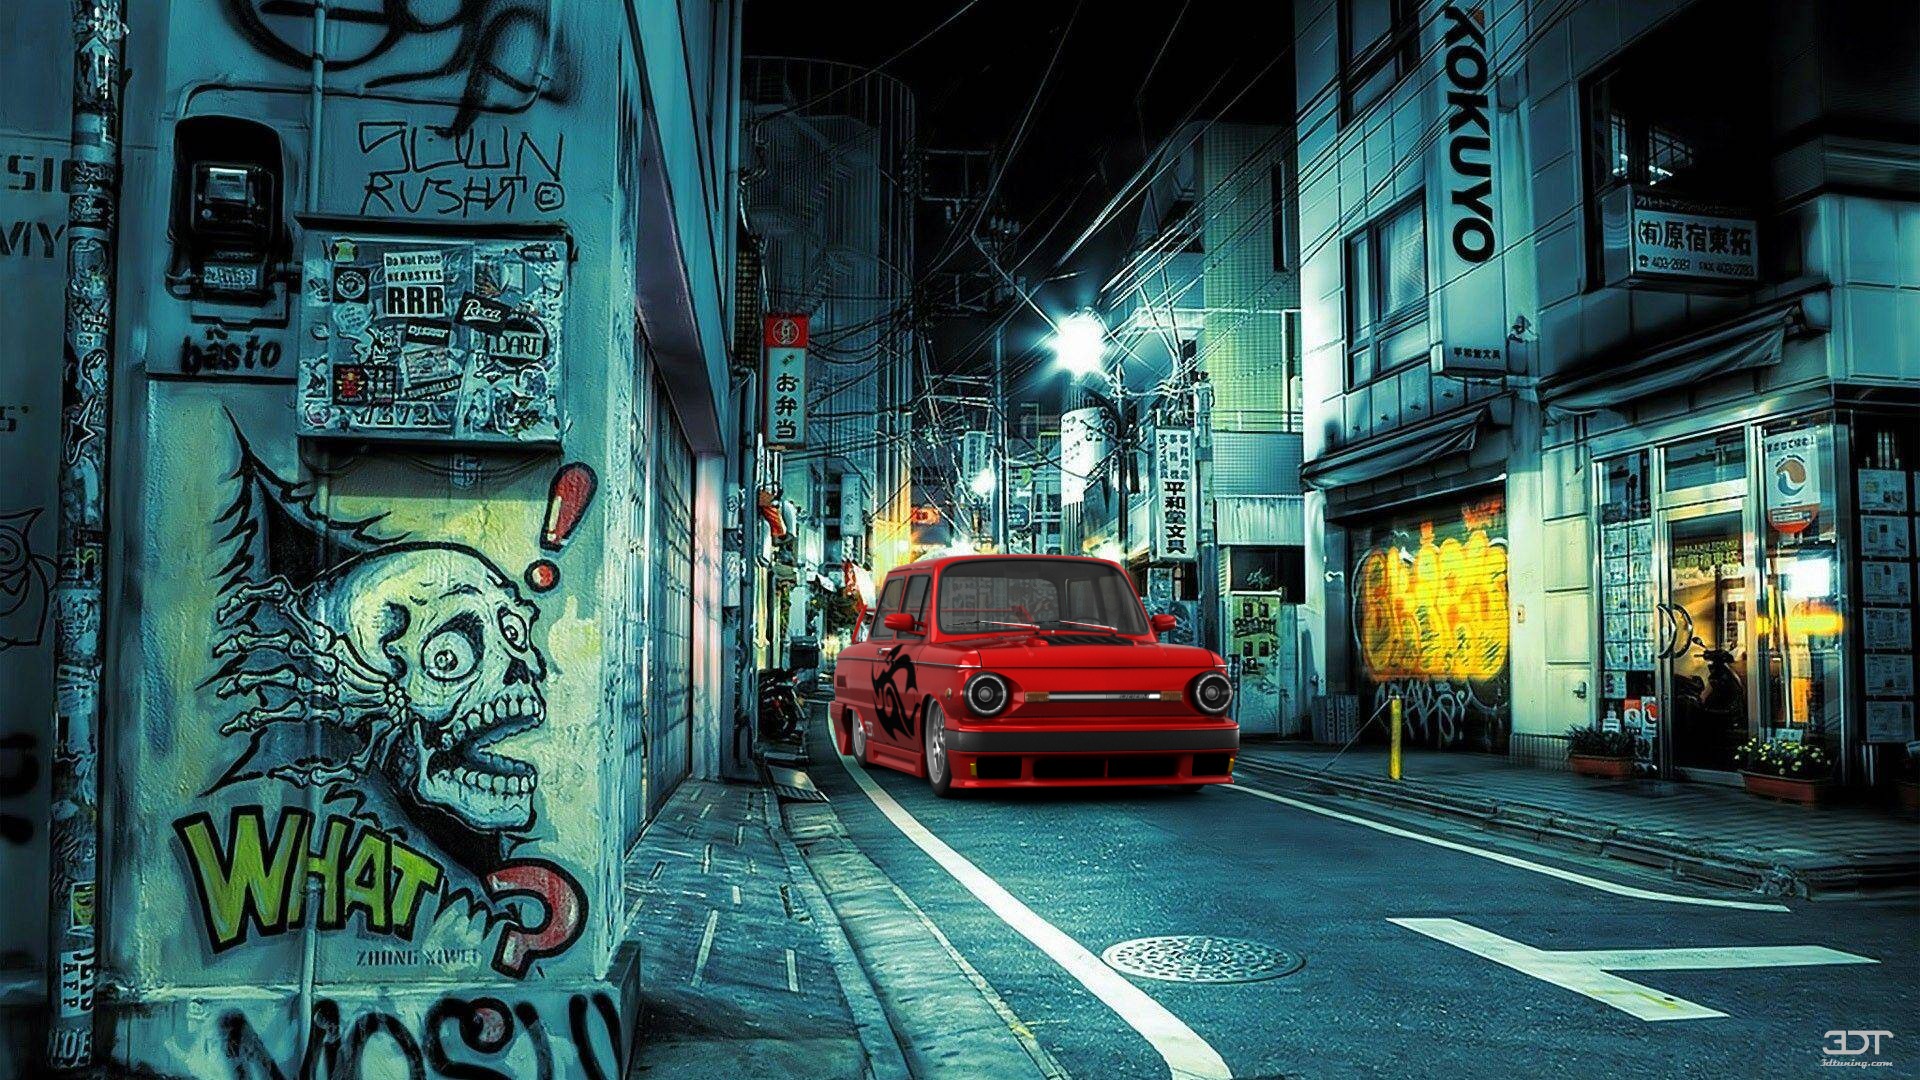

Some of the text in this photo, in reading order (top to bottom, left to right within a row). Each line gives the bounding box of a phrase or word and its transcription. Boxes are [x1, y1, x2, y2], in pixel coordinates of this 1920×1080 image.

[1445, 5, 1495, 264] KOKUYO
[388, 286, 444, 314] RRR
[775, 372, 800, 440] お弁当
[171, 804, 444, 954] WHAT
